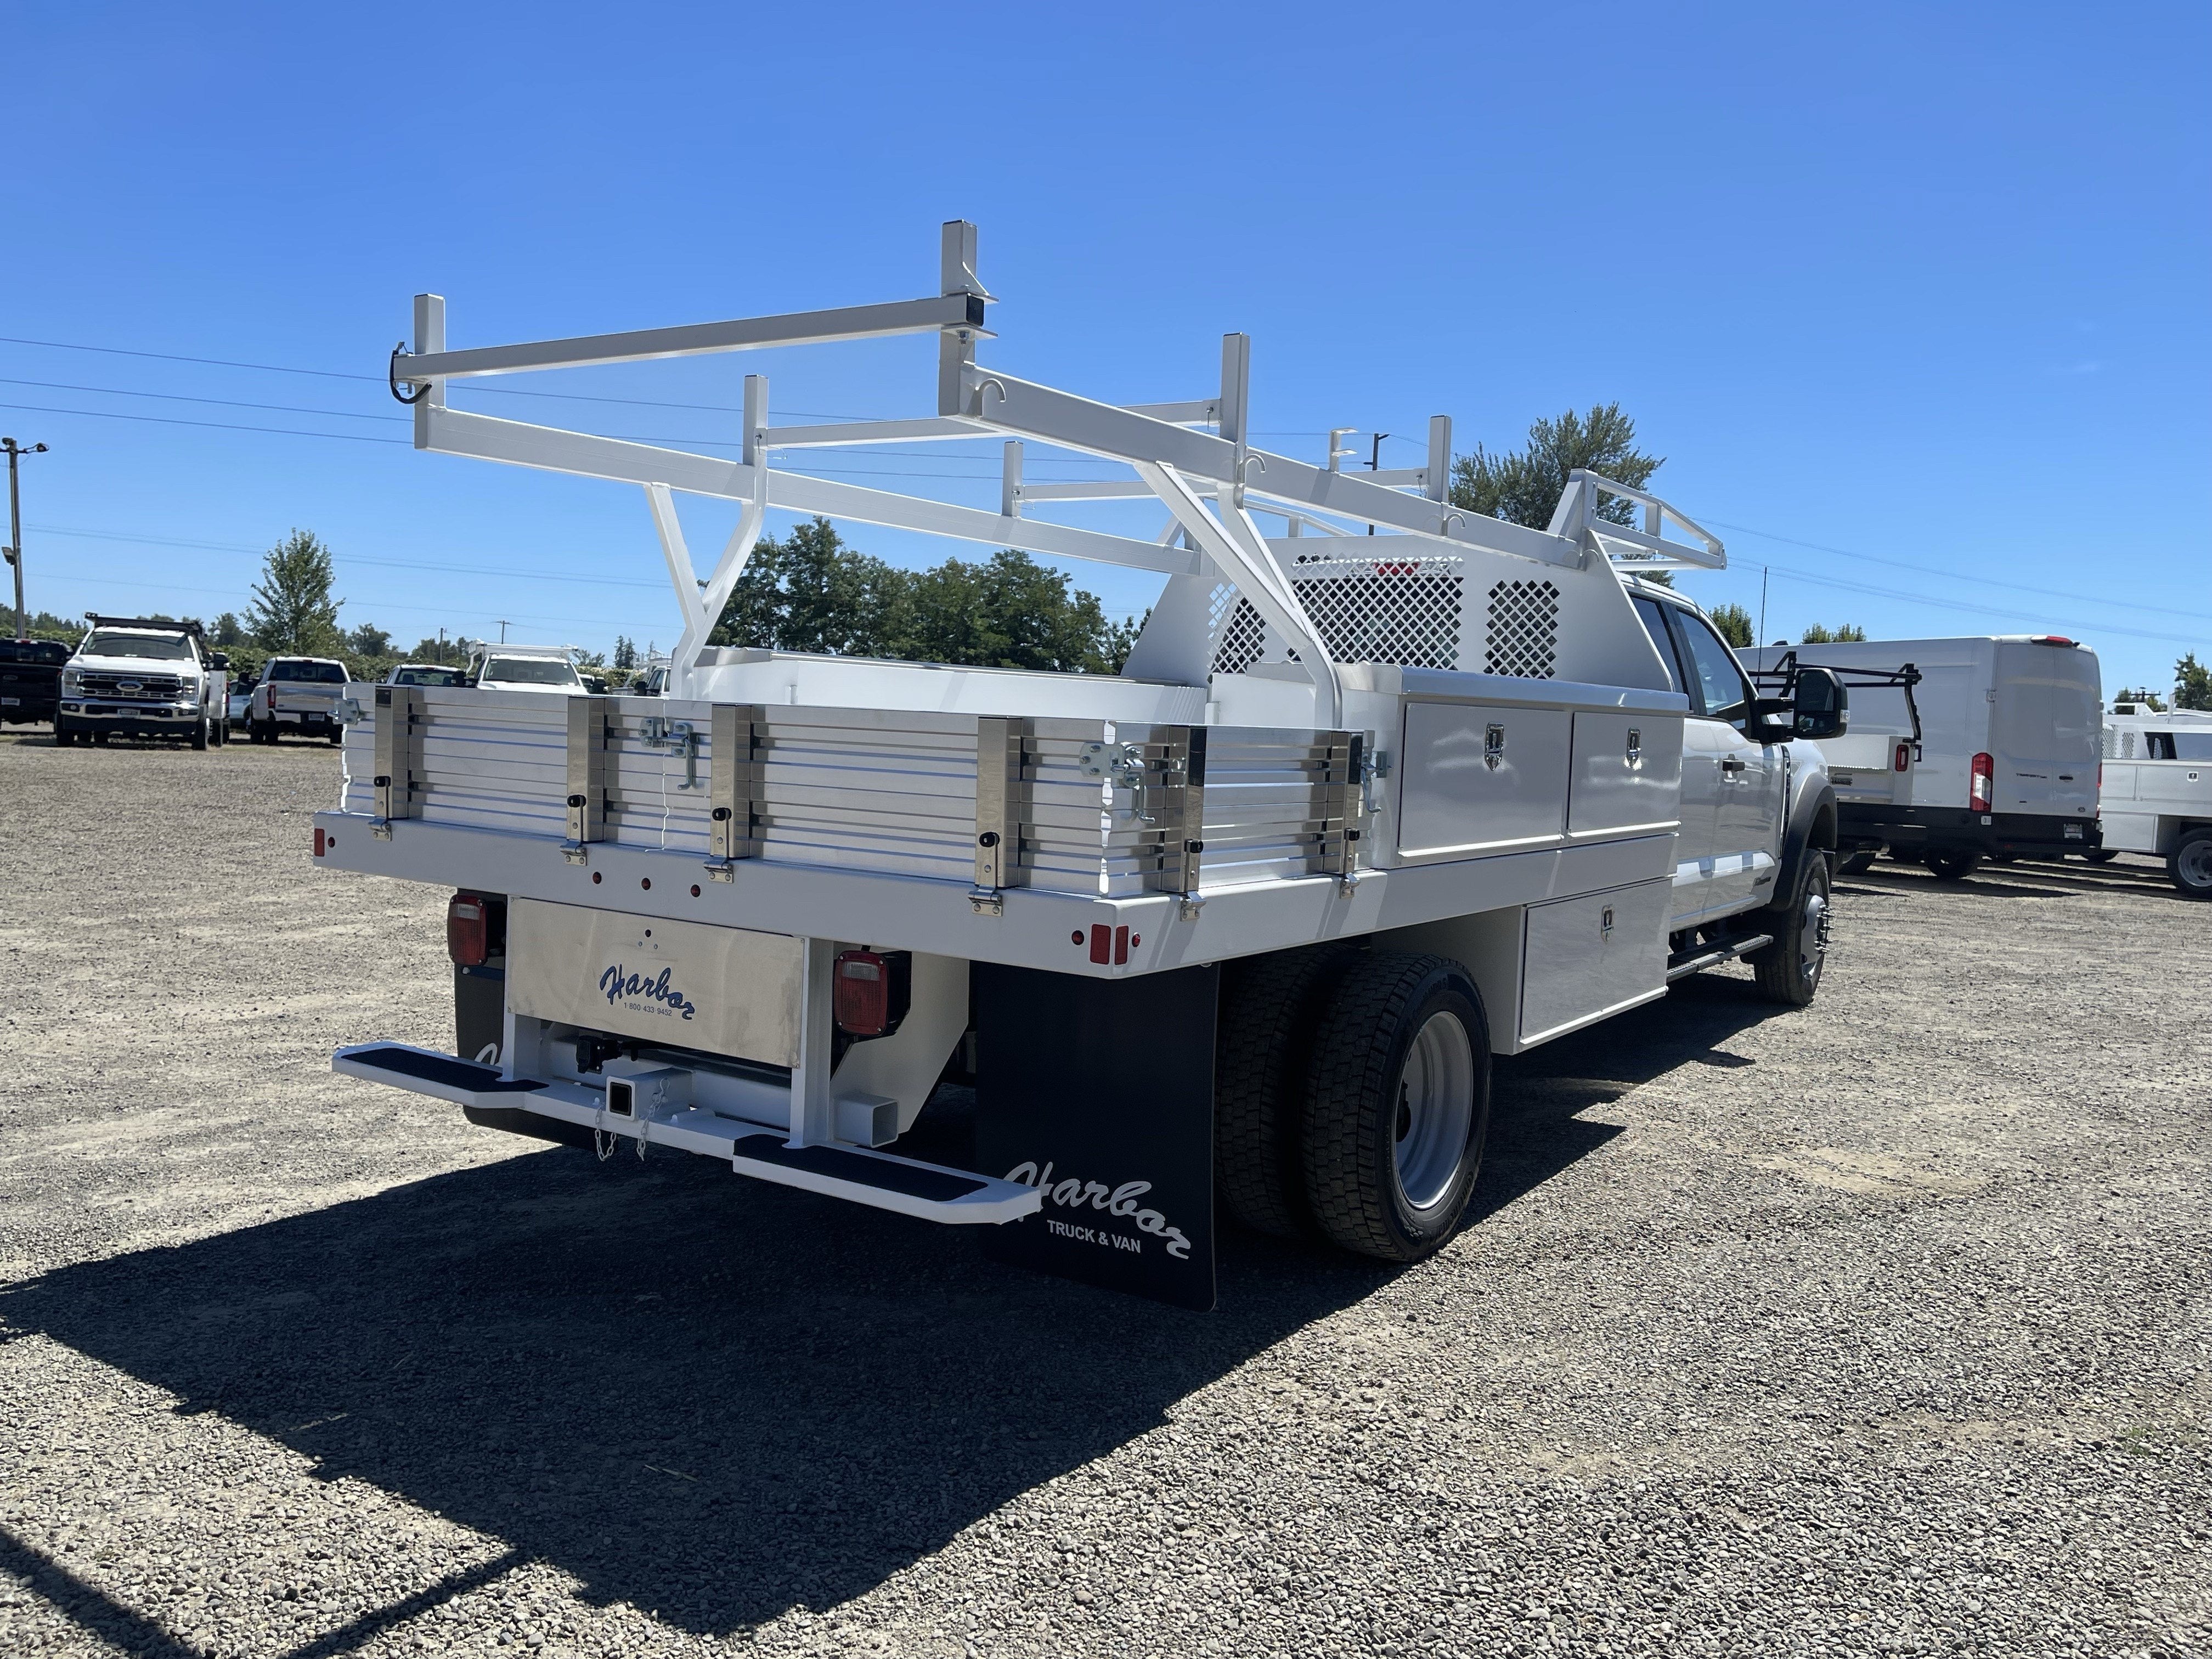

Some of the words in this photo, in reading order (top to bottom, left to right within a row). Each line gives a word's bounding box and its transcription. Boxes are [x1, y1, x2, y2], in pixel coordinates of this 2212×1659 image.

[600, 964, 695, 1020] Harbor
[657, 1008, 672, 1016] 9452
[1047, 1220, 1096, 1243] TRUCK
[1098, 1232, 1109, 1245] &
[1111, 1234, 1141, 1253] VAN
